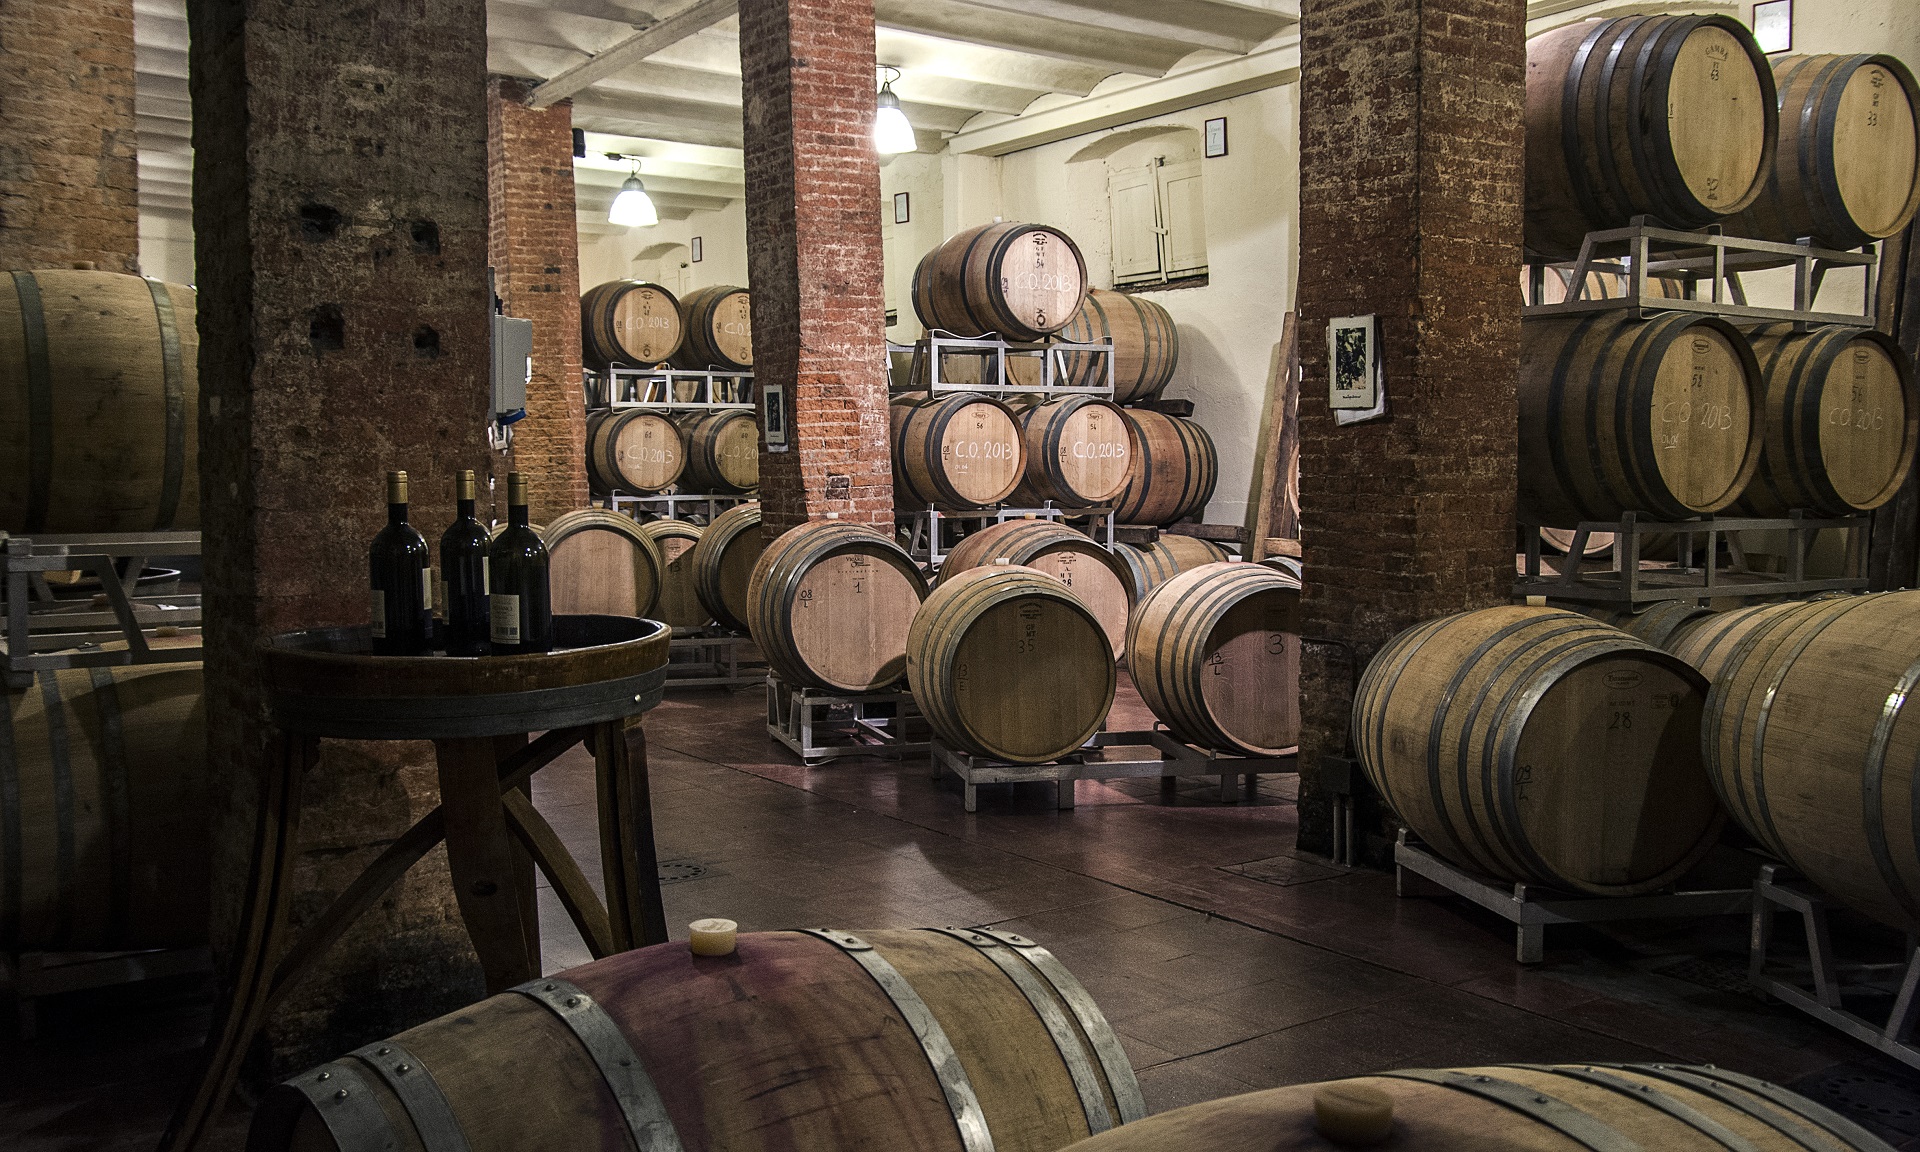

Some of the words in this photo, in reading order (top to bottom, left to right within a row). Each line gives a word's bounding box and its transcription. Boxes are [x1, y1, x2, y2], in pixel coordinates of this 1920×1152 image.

[1042, 273, 1072, 292] 2013
[648, 316, 670, 330] 2013
[1700, 402, 1732, 430] 2013
[1856, 407, 1884, 430] 2013
[650, 448, 674, 464] 2013
[743, 447, 757, 460] 20
[955, 440, 980, 459] C.O.
[983, 441, 1013, 460] 2013
[1073, 441, 1098, 459] C.O.
[1099, 442, 1125, 459] 2013
[801, 589, 813, 599] 08
[1018, 639, 1034, 654] 35
[1268, 634, 1284, 655] 3
[1209, 652, 1222, 664] 13
[1609, 711, 1632, 730] 28
